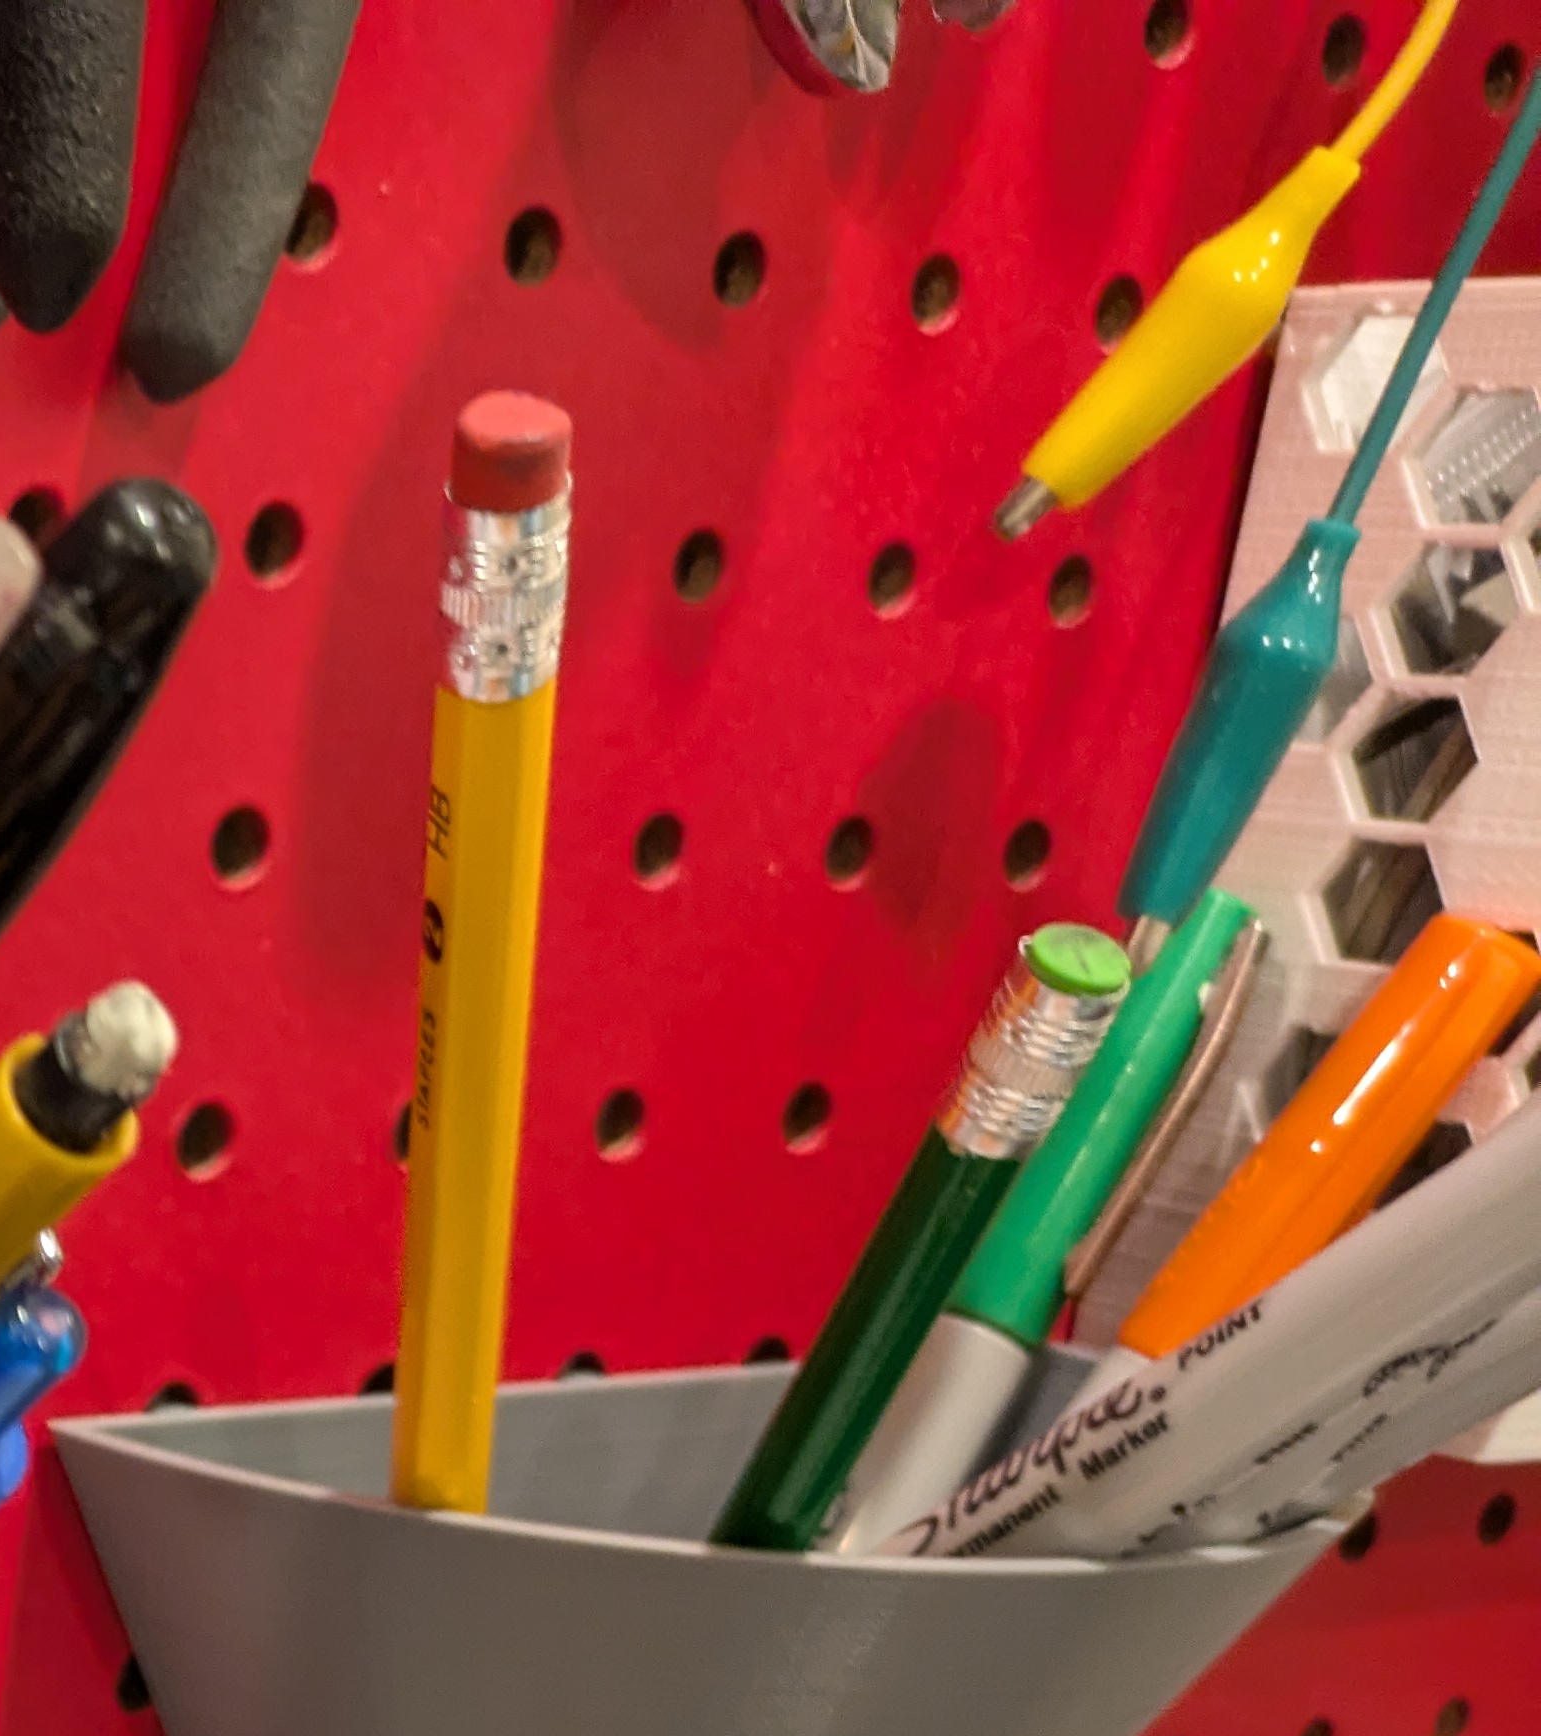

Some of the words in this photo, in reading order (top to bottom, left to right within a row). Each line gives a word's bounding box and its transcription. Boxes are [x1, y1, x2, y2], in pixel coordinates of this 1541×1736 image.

[426, 782, 453, 861] HB
[417, 1010, 438, 1131] STAPLES
[1178, 1299, 1264, 1370] POINT
[1078, 1410, 1170, 1481] Marker
